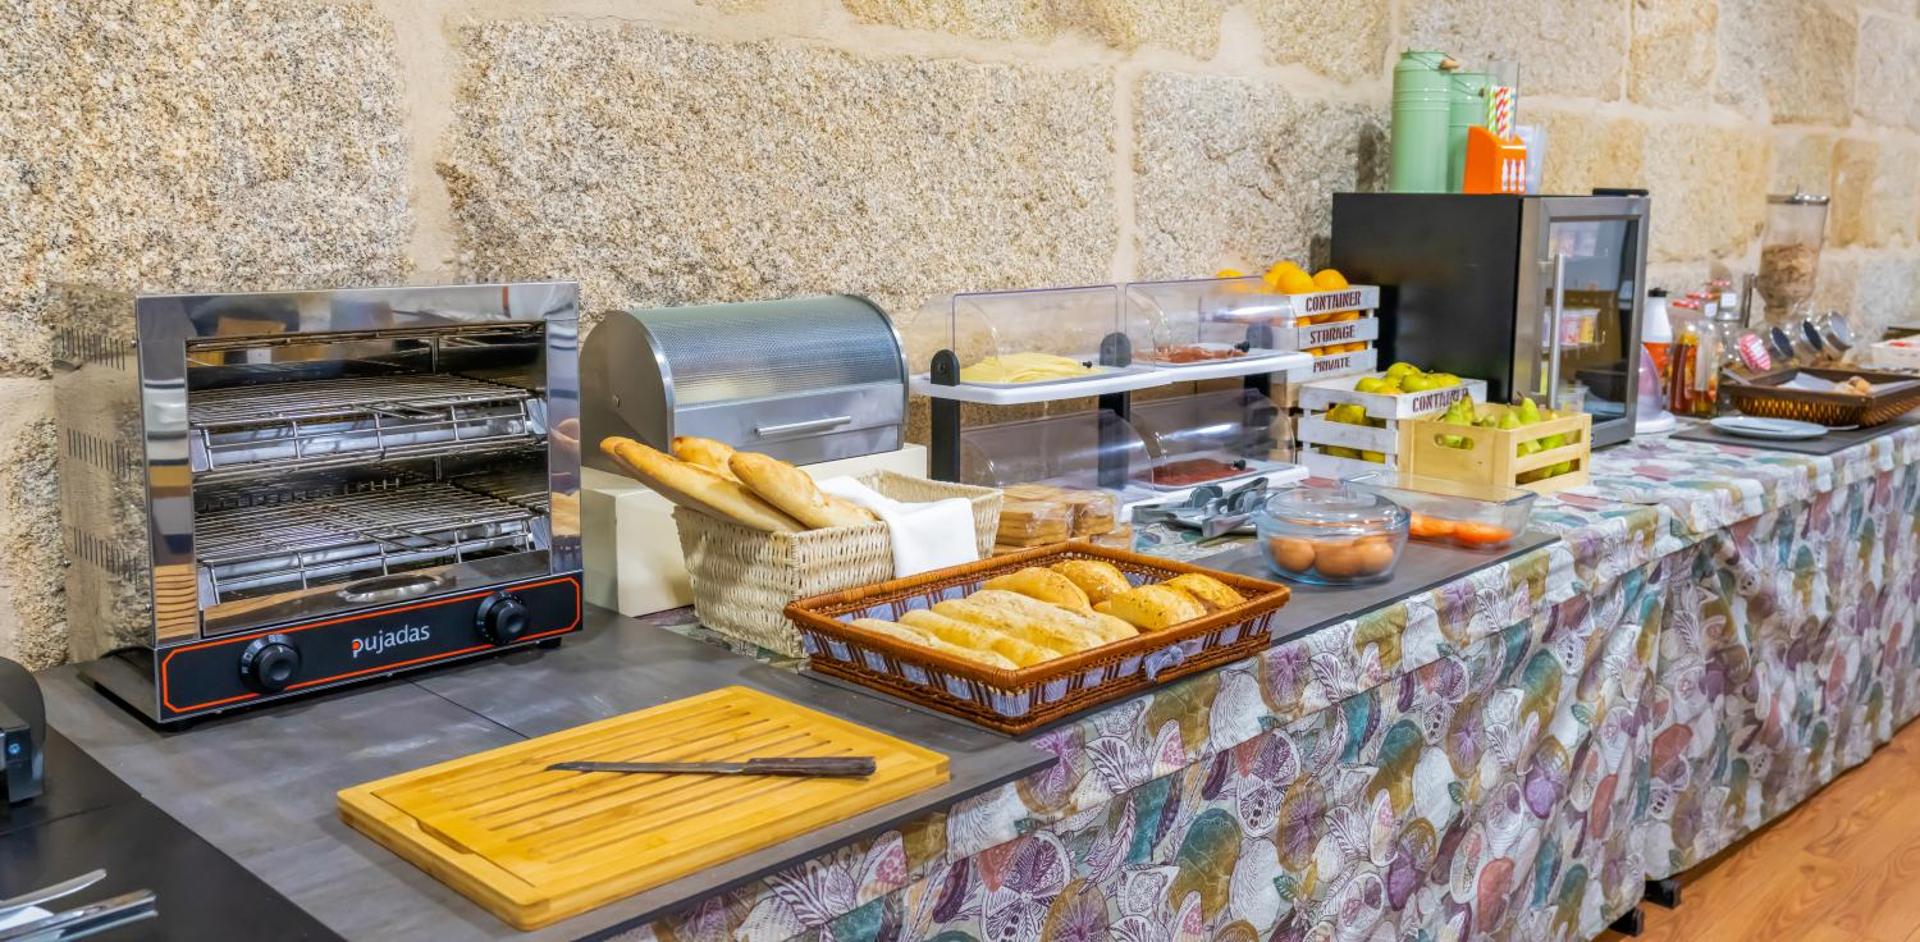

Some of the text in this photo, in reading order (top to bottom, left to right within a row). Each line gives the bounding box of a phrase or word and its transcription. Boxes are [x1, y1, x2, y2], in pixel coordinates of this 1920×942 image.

[1306, 290, 1361, 312] CONTAINER
[1310, 325, 1355, 344] STORAGE
[1313, 356, 1351, 373] PRIVATE
[352, 623, 430, 658] pujadas
